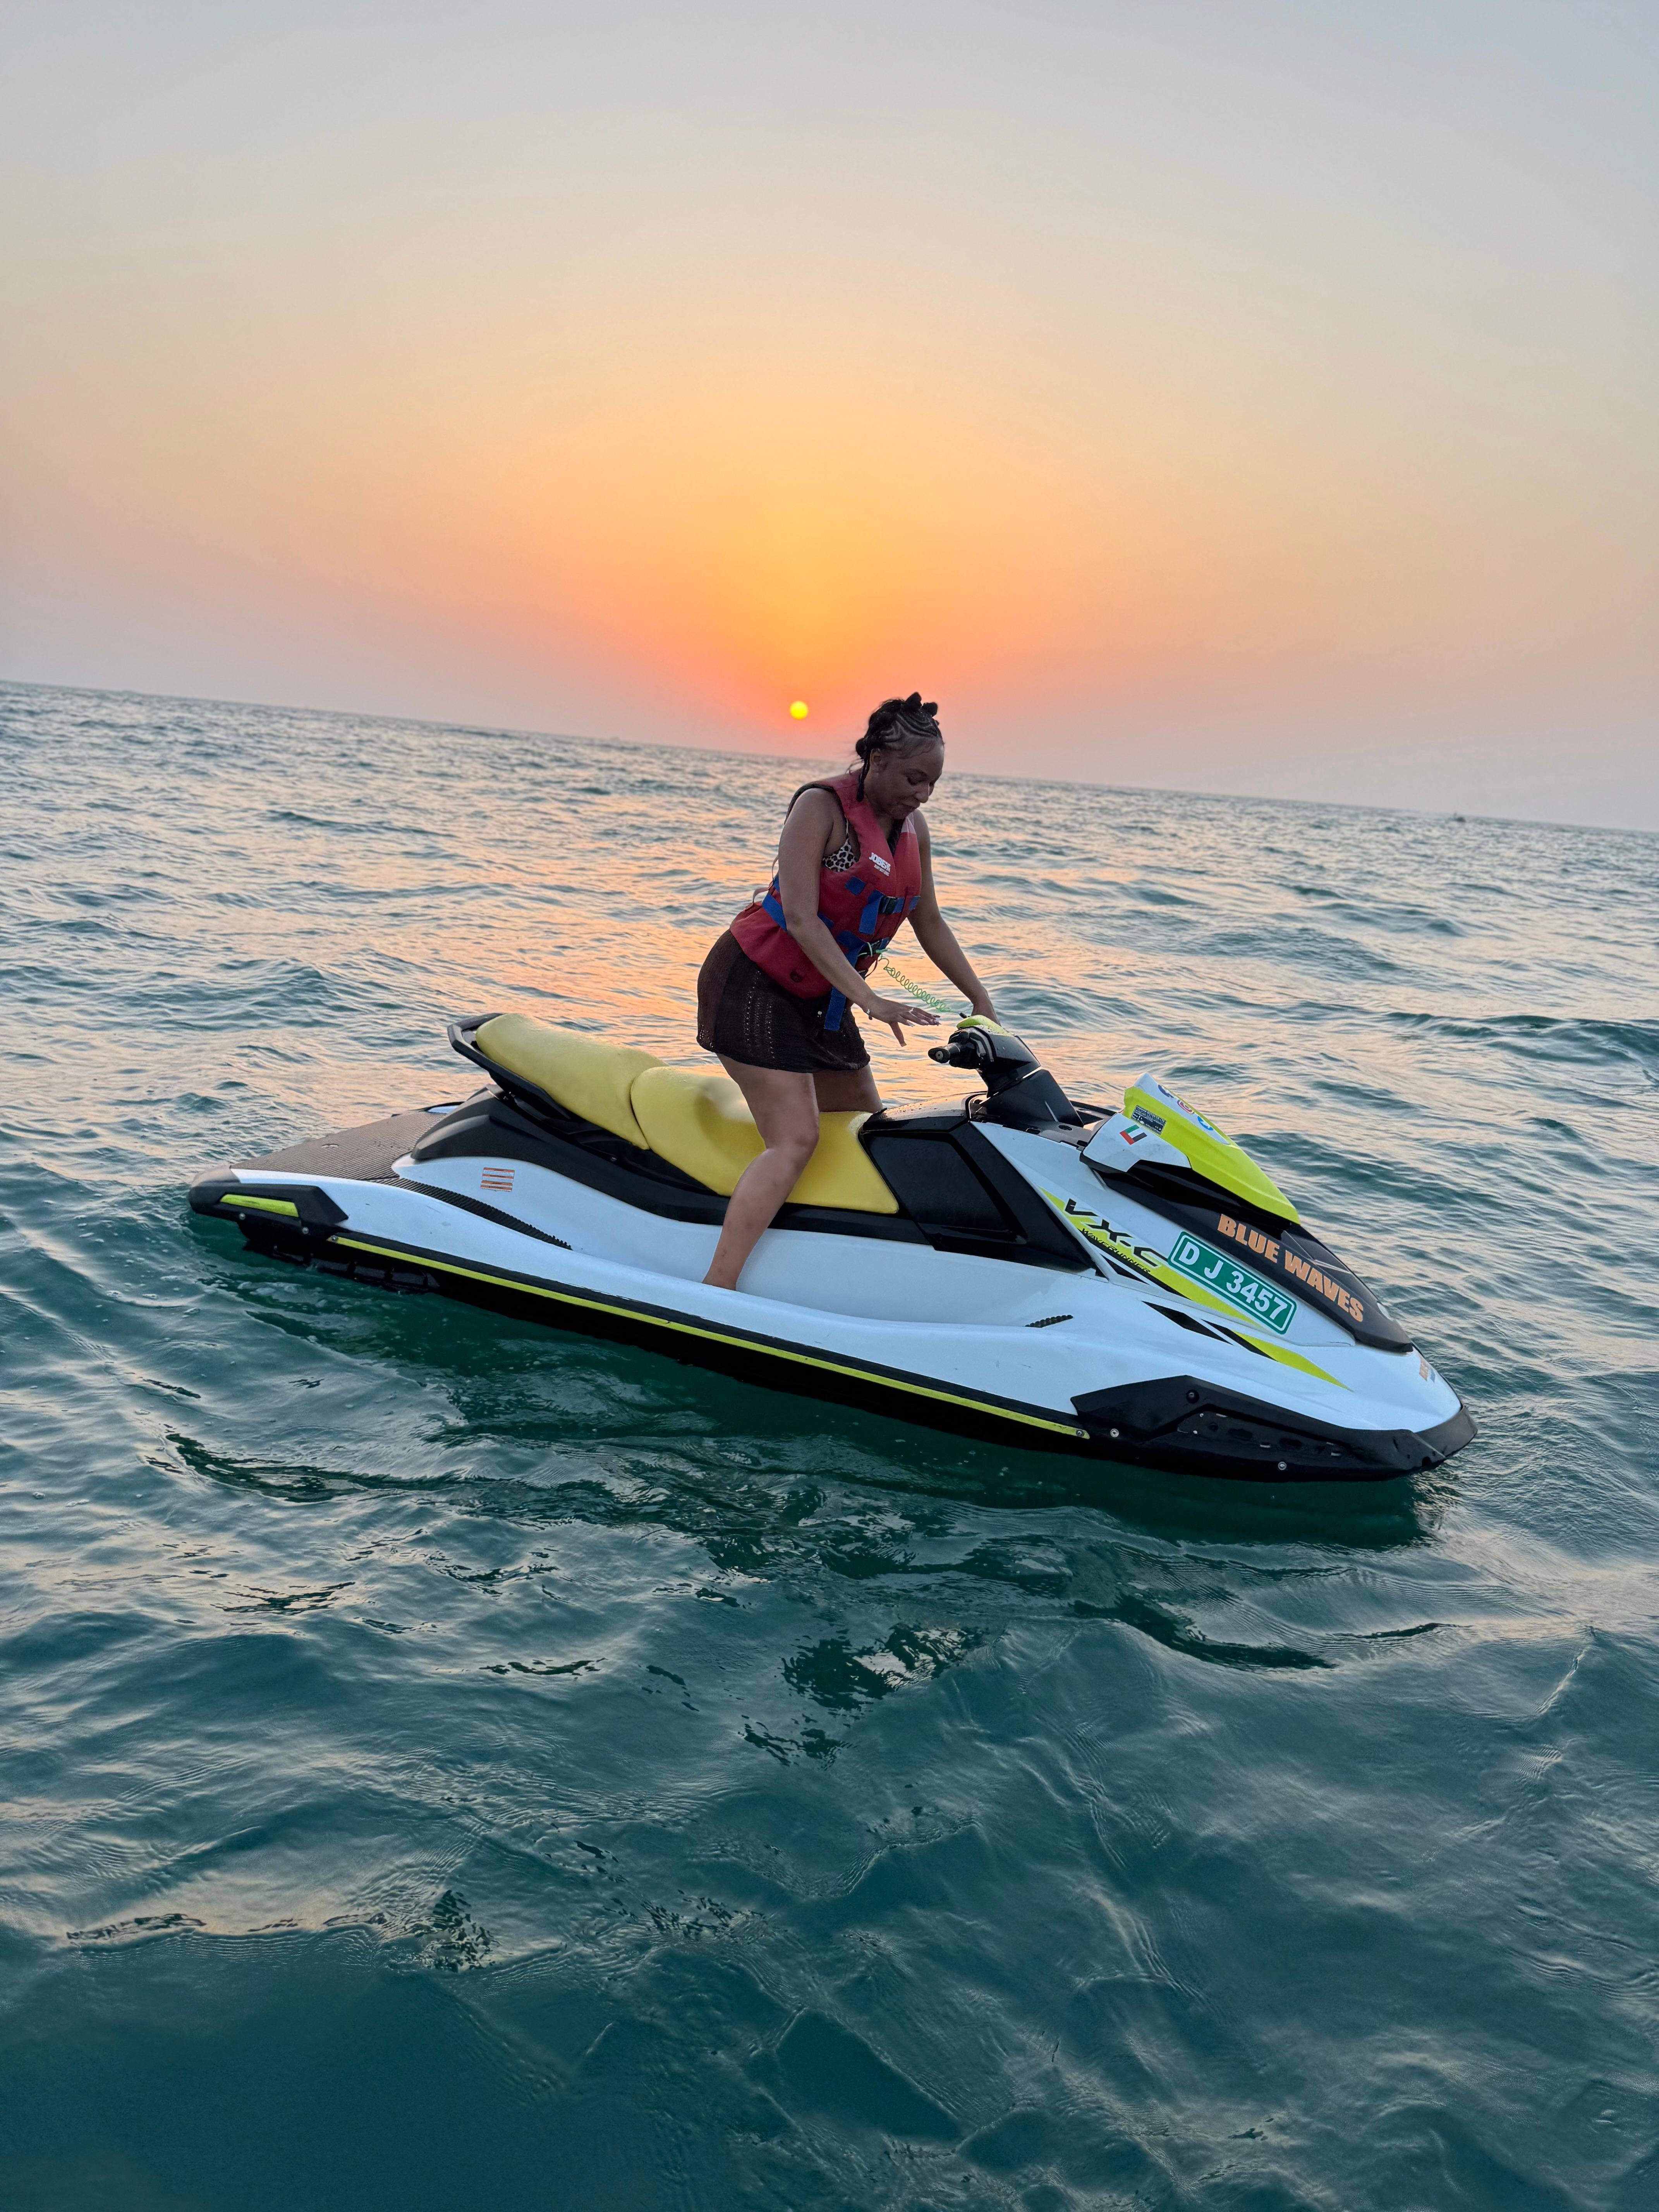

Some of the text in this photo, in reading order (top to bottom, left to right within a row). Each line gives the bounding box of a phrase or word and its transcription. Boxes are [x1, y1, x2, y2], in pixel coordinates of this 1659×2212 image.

[1081, 1228, 1151, 1274] WAVERUNNER
[1178, 1242, 1288, 1320] D J 3457
[1218, 1214, 1364, 1322] BLUE WAVES
